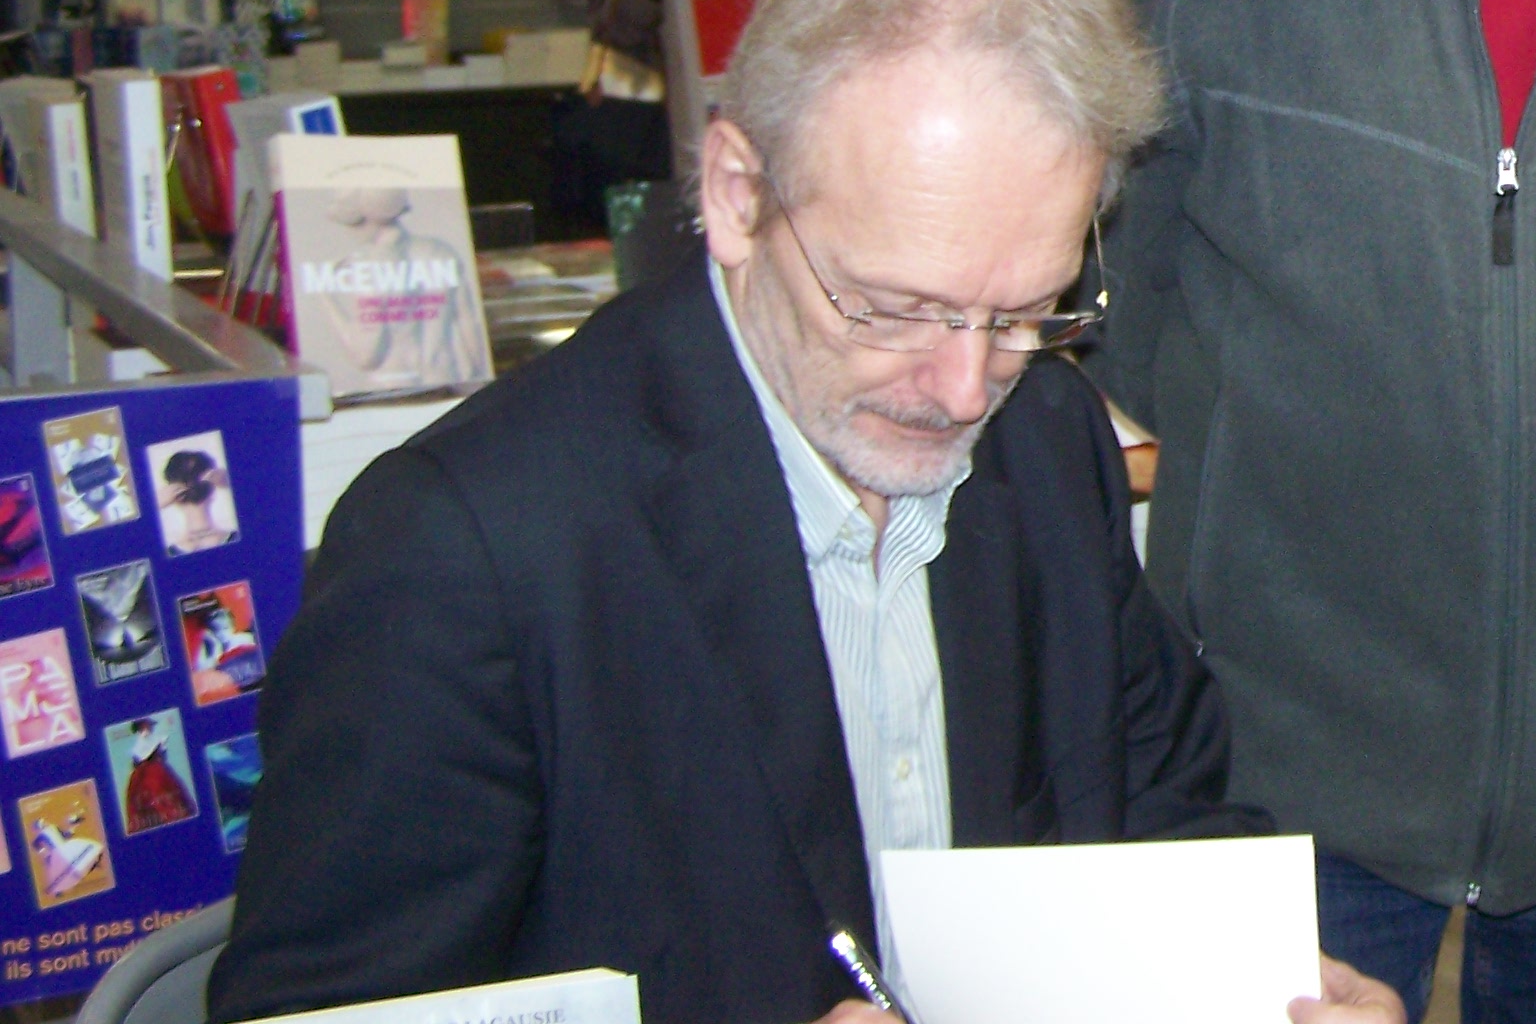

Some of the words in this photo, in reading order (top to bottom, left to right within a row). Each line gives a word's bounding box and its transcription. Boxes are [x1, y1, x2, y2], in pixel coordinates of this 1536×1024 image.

[2, 936, 31, 956] ne
[38, 925, 88, 950] sont
[93, 918, 135, 944] pas
[6, 960, 33, 981] ils
[39, 948, 90, 974] sont
